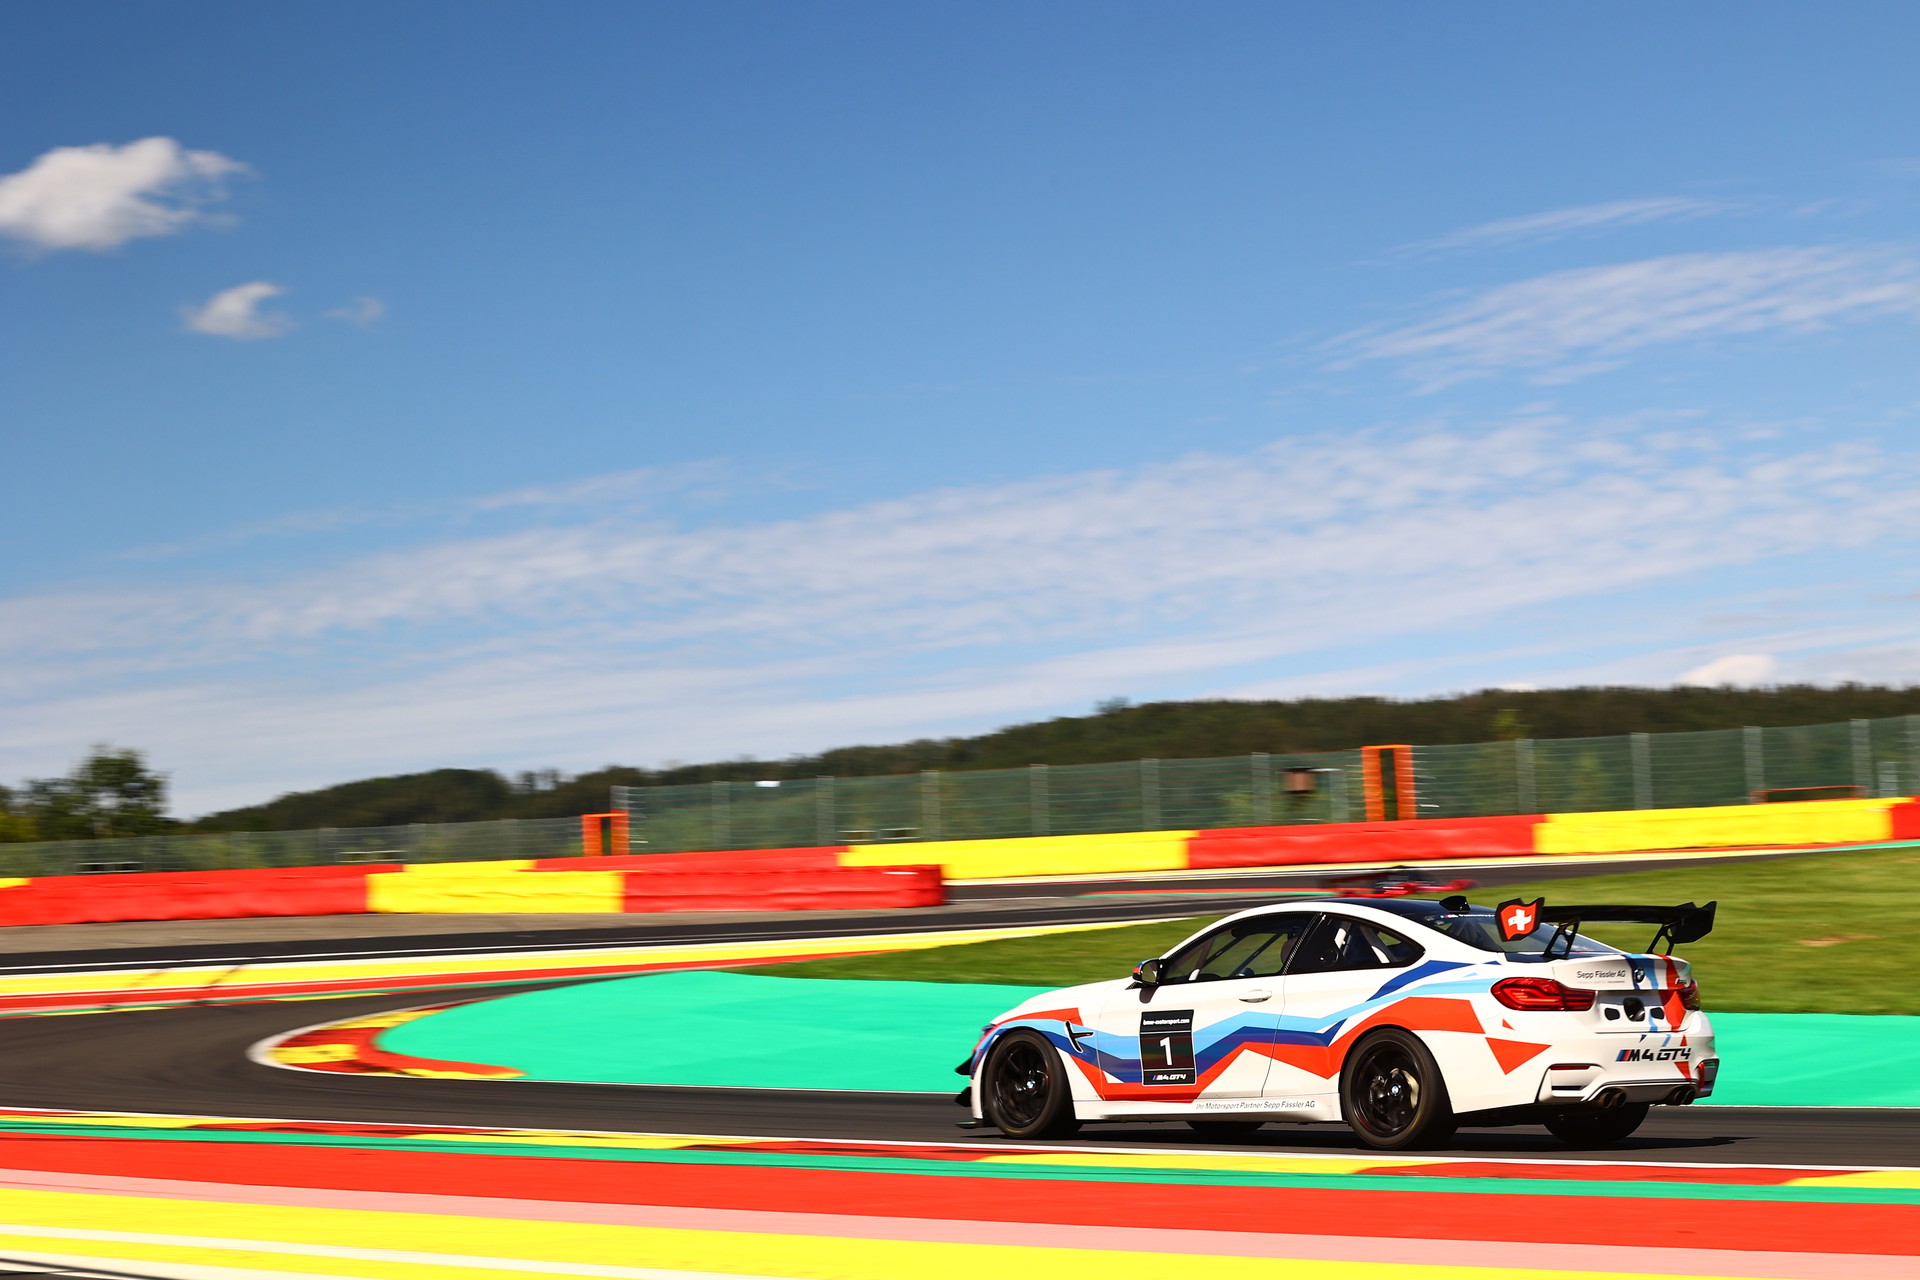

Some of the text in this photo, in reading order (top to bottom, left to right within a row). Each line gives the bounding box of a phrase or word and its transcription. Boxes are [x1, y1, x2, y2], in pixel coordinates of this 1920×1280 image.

[1577, 970, 1594, 979] Sepp
[1616, 969, 1626, 978] AG
[1159, 1036, 1173, 1066] 1
[1656, 1047, 1692, 1061] GT4
[1205, 1102, 1239, 1110] Motorsport
[1240, 1101, 1262, 1109] Partner
[1263, 1101, 1280, 1109] Sepp
[1305, 1100, 1316, 1108] AG
